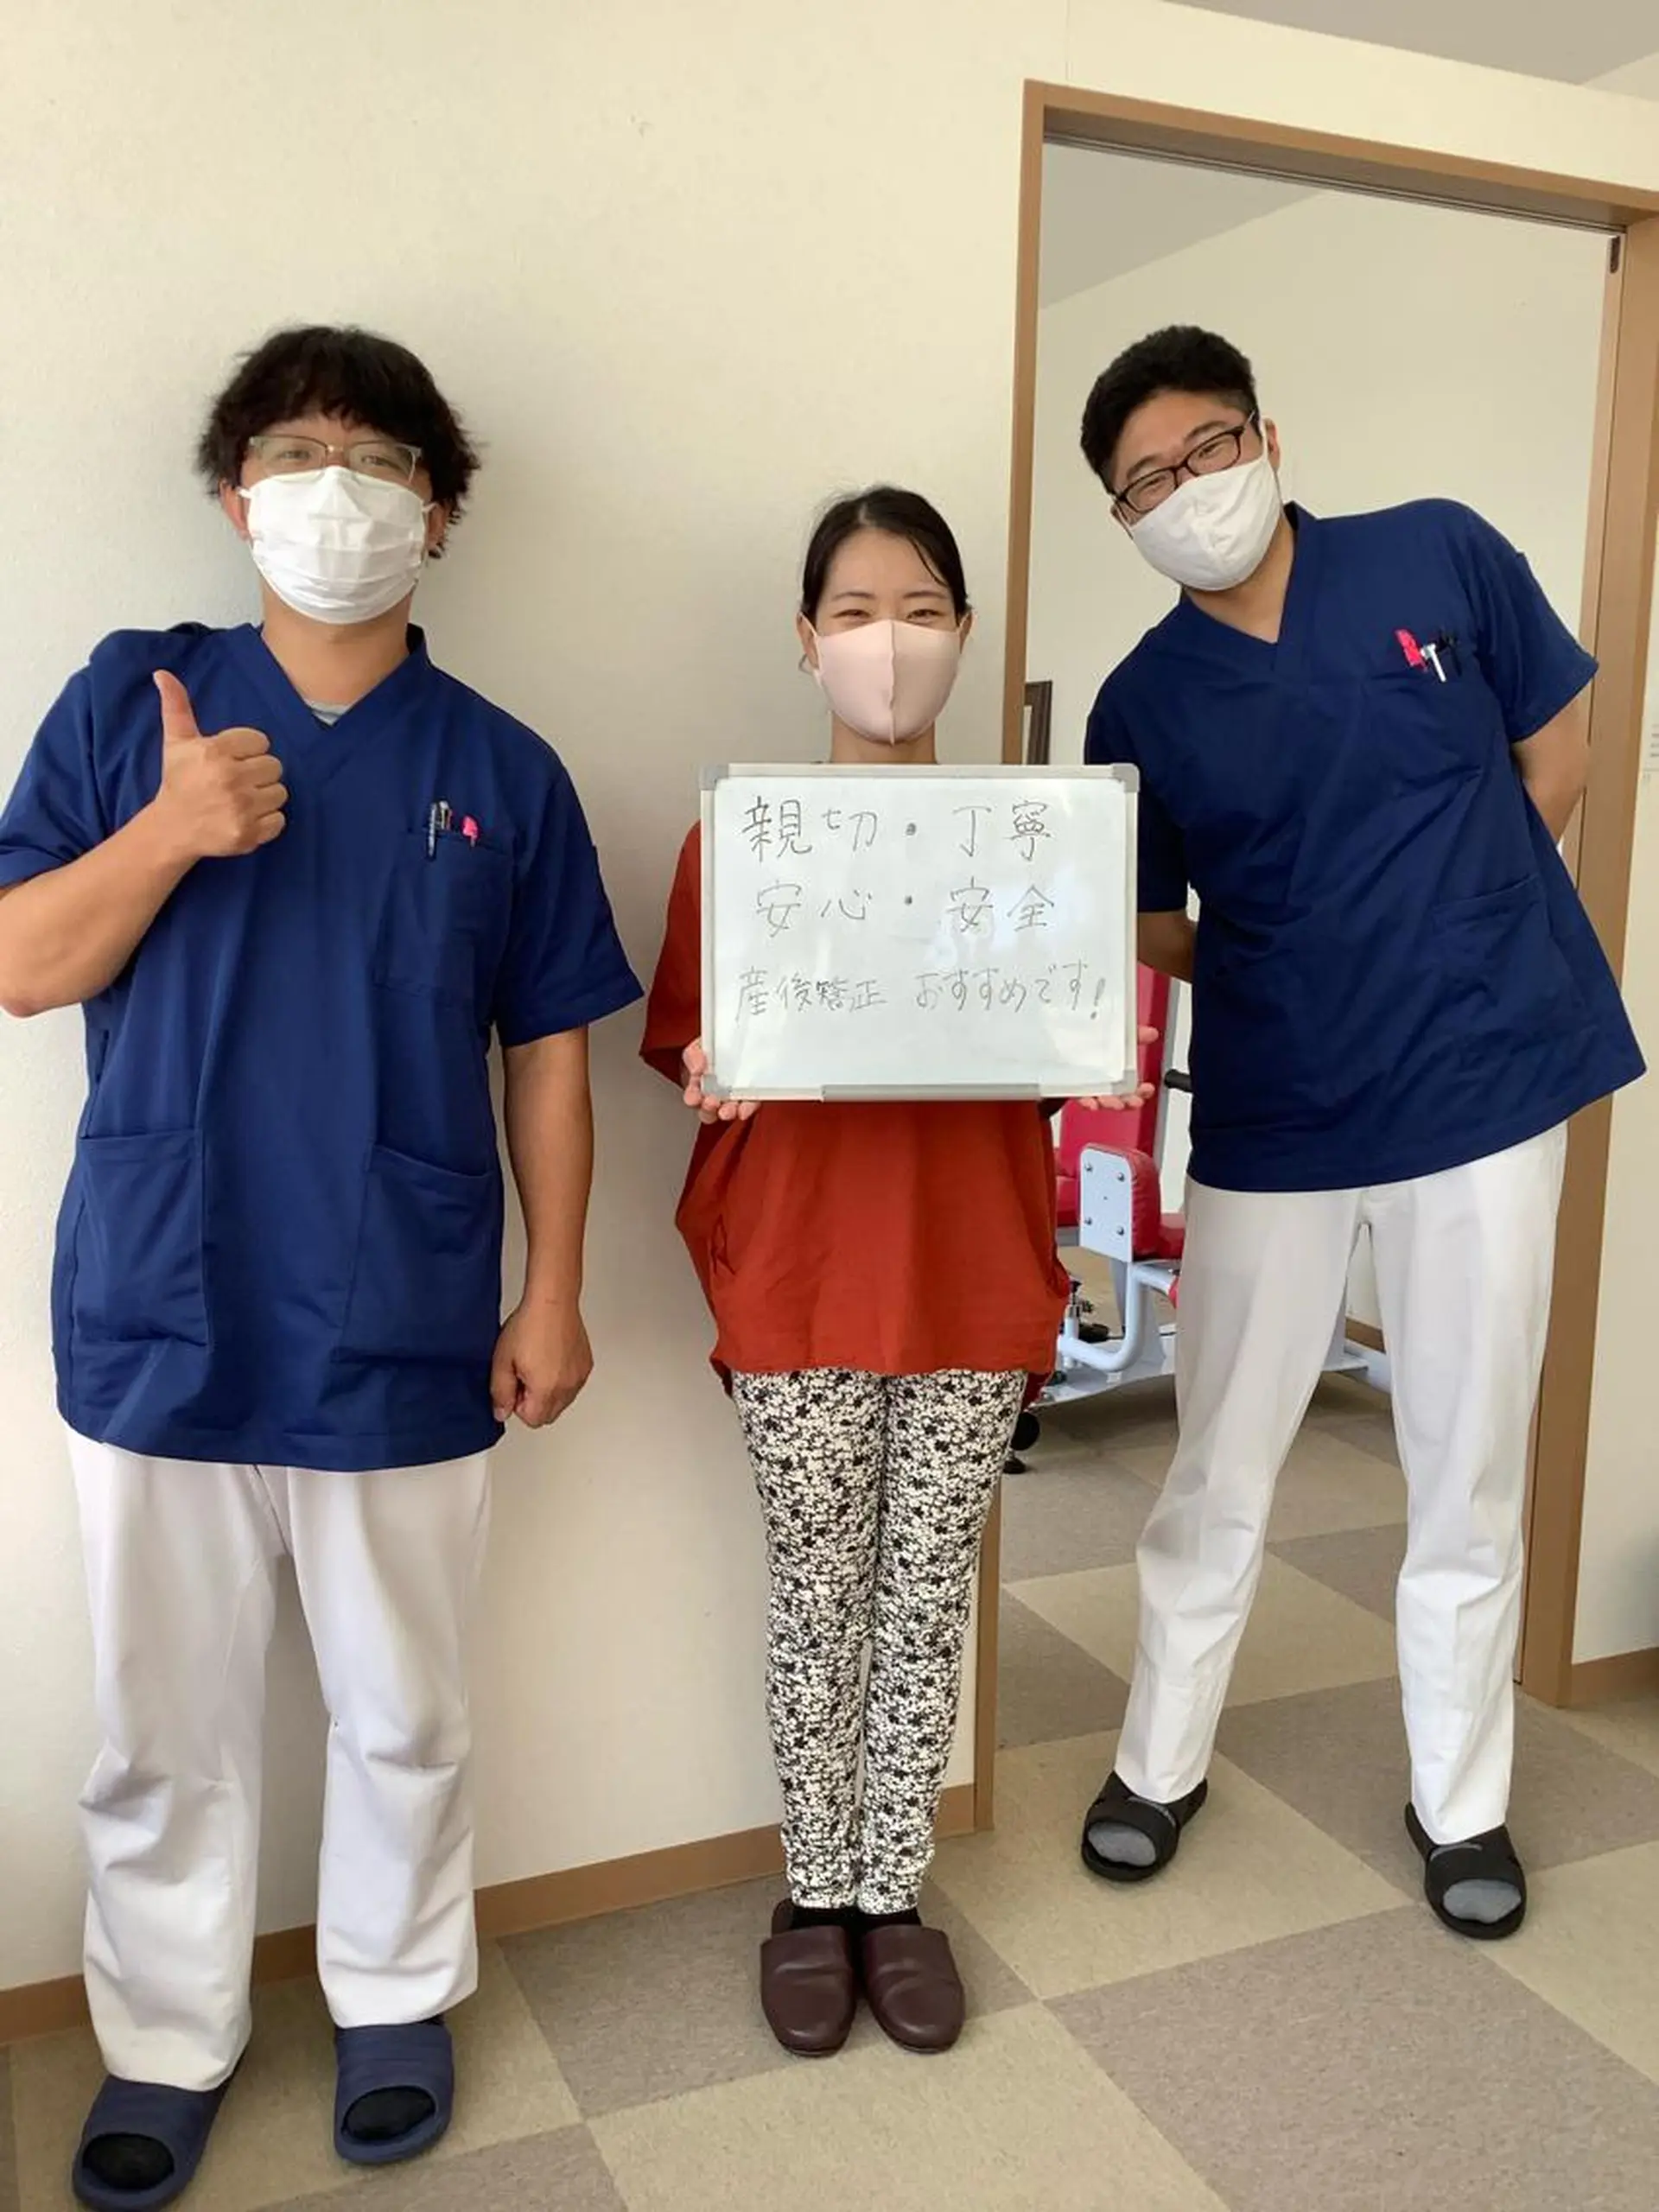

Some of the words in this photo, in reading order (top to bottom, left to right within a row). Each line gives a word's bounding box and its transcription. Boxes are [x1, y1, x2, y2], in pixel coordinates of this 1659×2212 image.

[755, 876, 1055, 938] 安心・安全
[735, 964, 888, 1023] 産後矯正
